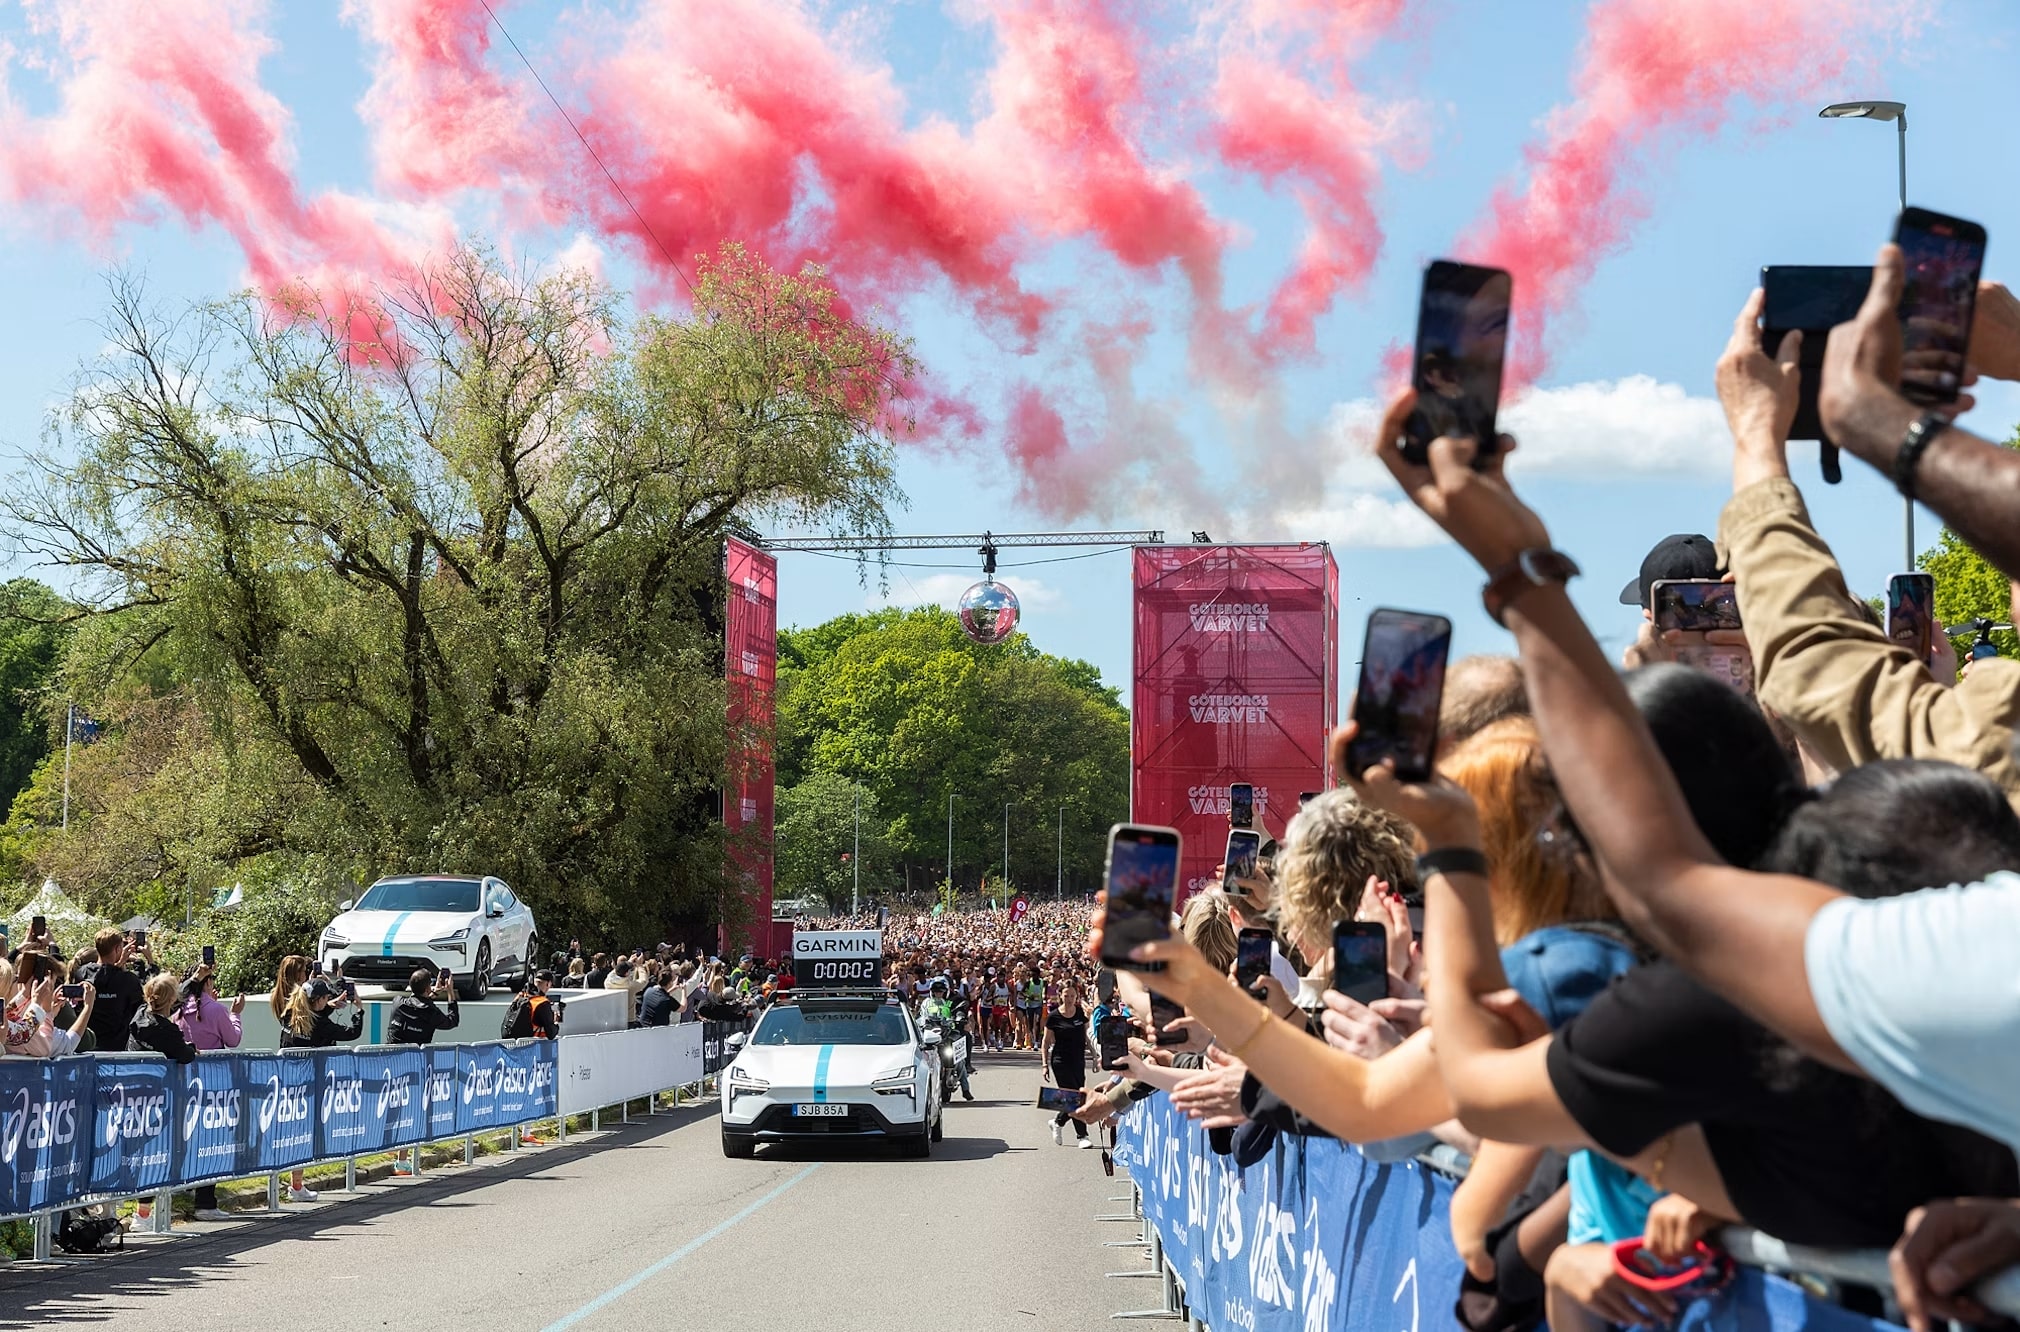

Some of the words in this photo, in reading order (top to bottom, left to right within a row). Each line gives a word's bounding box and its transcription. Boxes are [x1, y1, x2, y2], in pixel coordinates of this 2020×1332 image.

[1189, 602, 1270, 615] GÖTEBORGS
[1190, 615, 1269, 632] VARVET
[1188, 693, 1269, 706] GÖTEBORGS
[1189, 707, 1269, 723] VARVET
[1188, 785, 1269, 798] GÖTEBGS
[1189, 798, 1268, 815] VART
[801, 1105, 821, 1115] SJB
[824, 1105, 844, 1115] 85A
